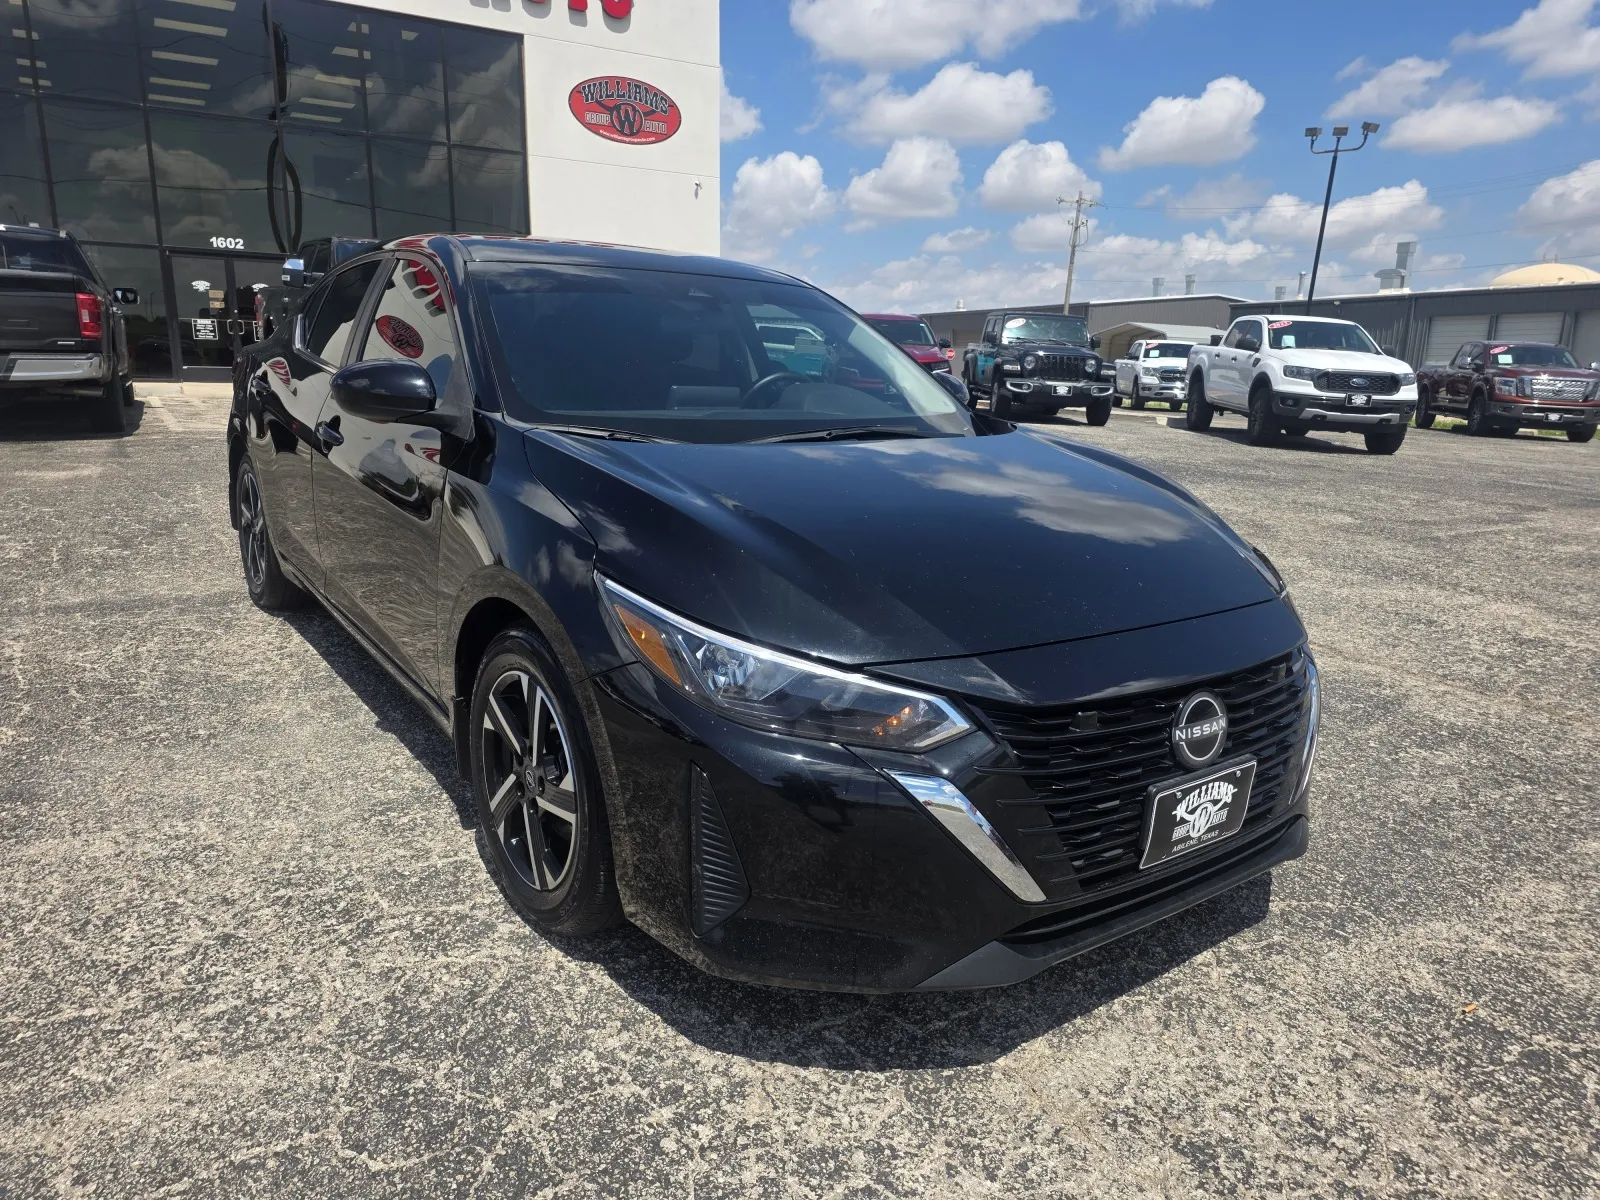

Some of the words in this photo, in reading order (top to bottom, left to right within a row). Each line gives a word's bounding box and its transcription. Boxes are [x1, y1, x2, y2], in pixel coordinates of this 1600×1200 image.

[581, 79, 669, 116] WILLIAMS
[585, 111, 611, 125] GROUP
[616, 104, 638, 135] W
[644, 120, 667, 134] AUTO
[209, 236, 245, 250] 1602
[1175, 717, 1226, 741] NISSAN
[1176, 781, 1234, 822] WILLIAMS
[1211, 809, 1228, 824] AUTO
[1201, 830, 1219, 841] TEXAS
